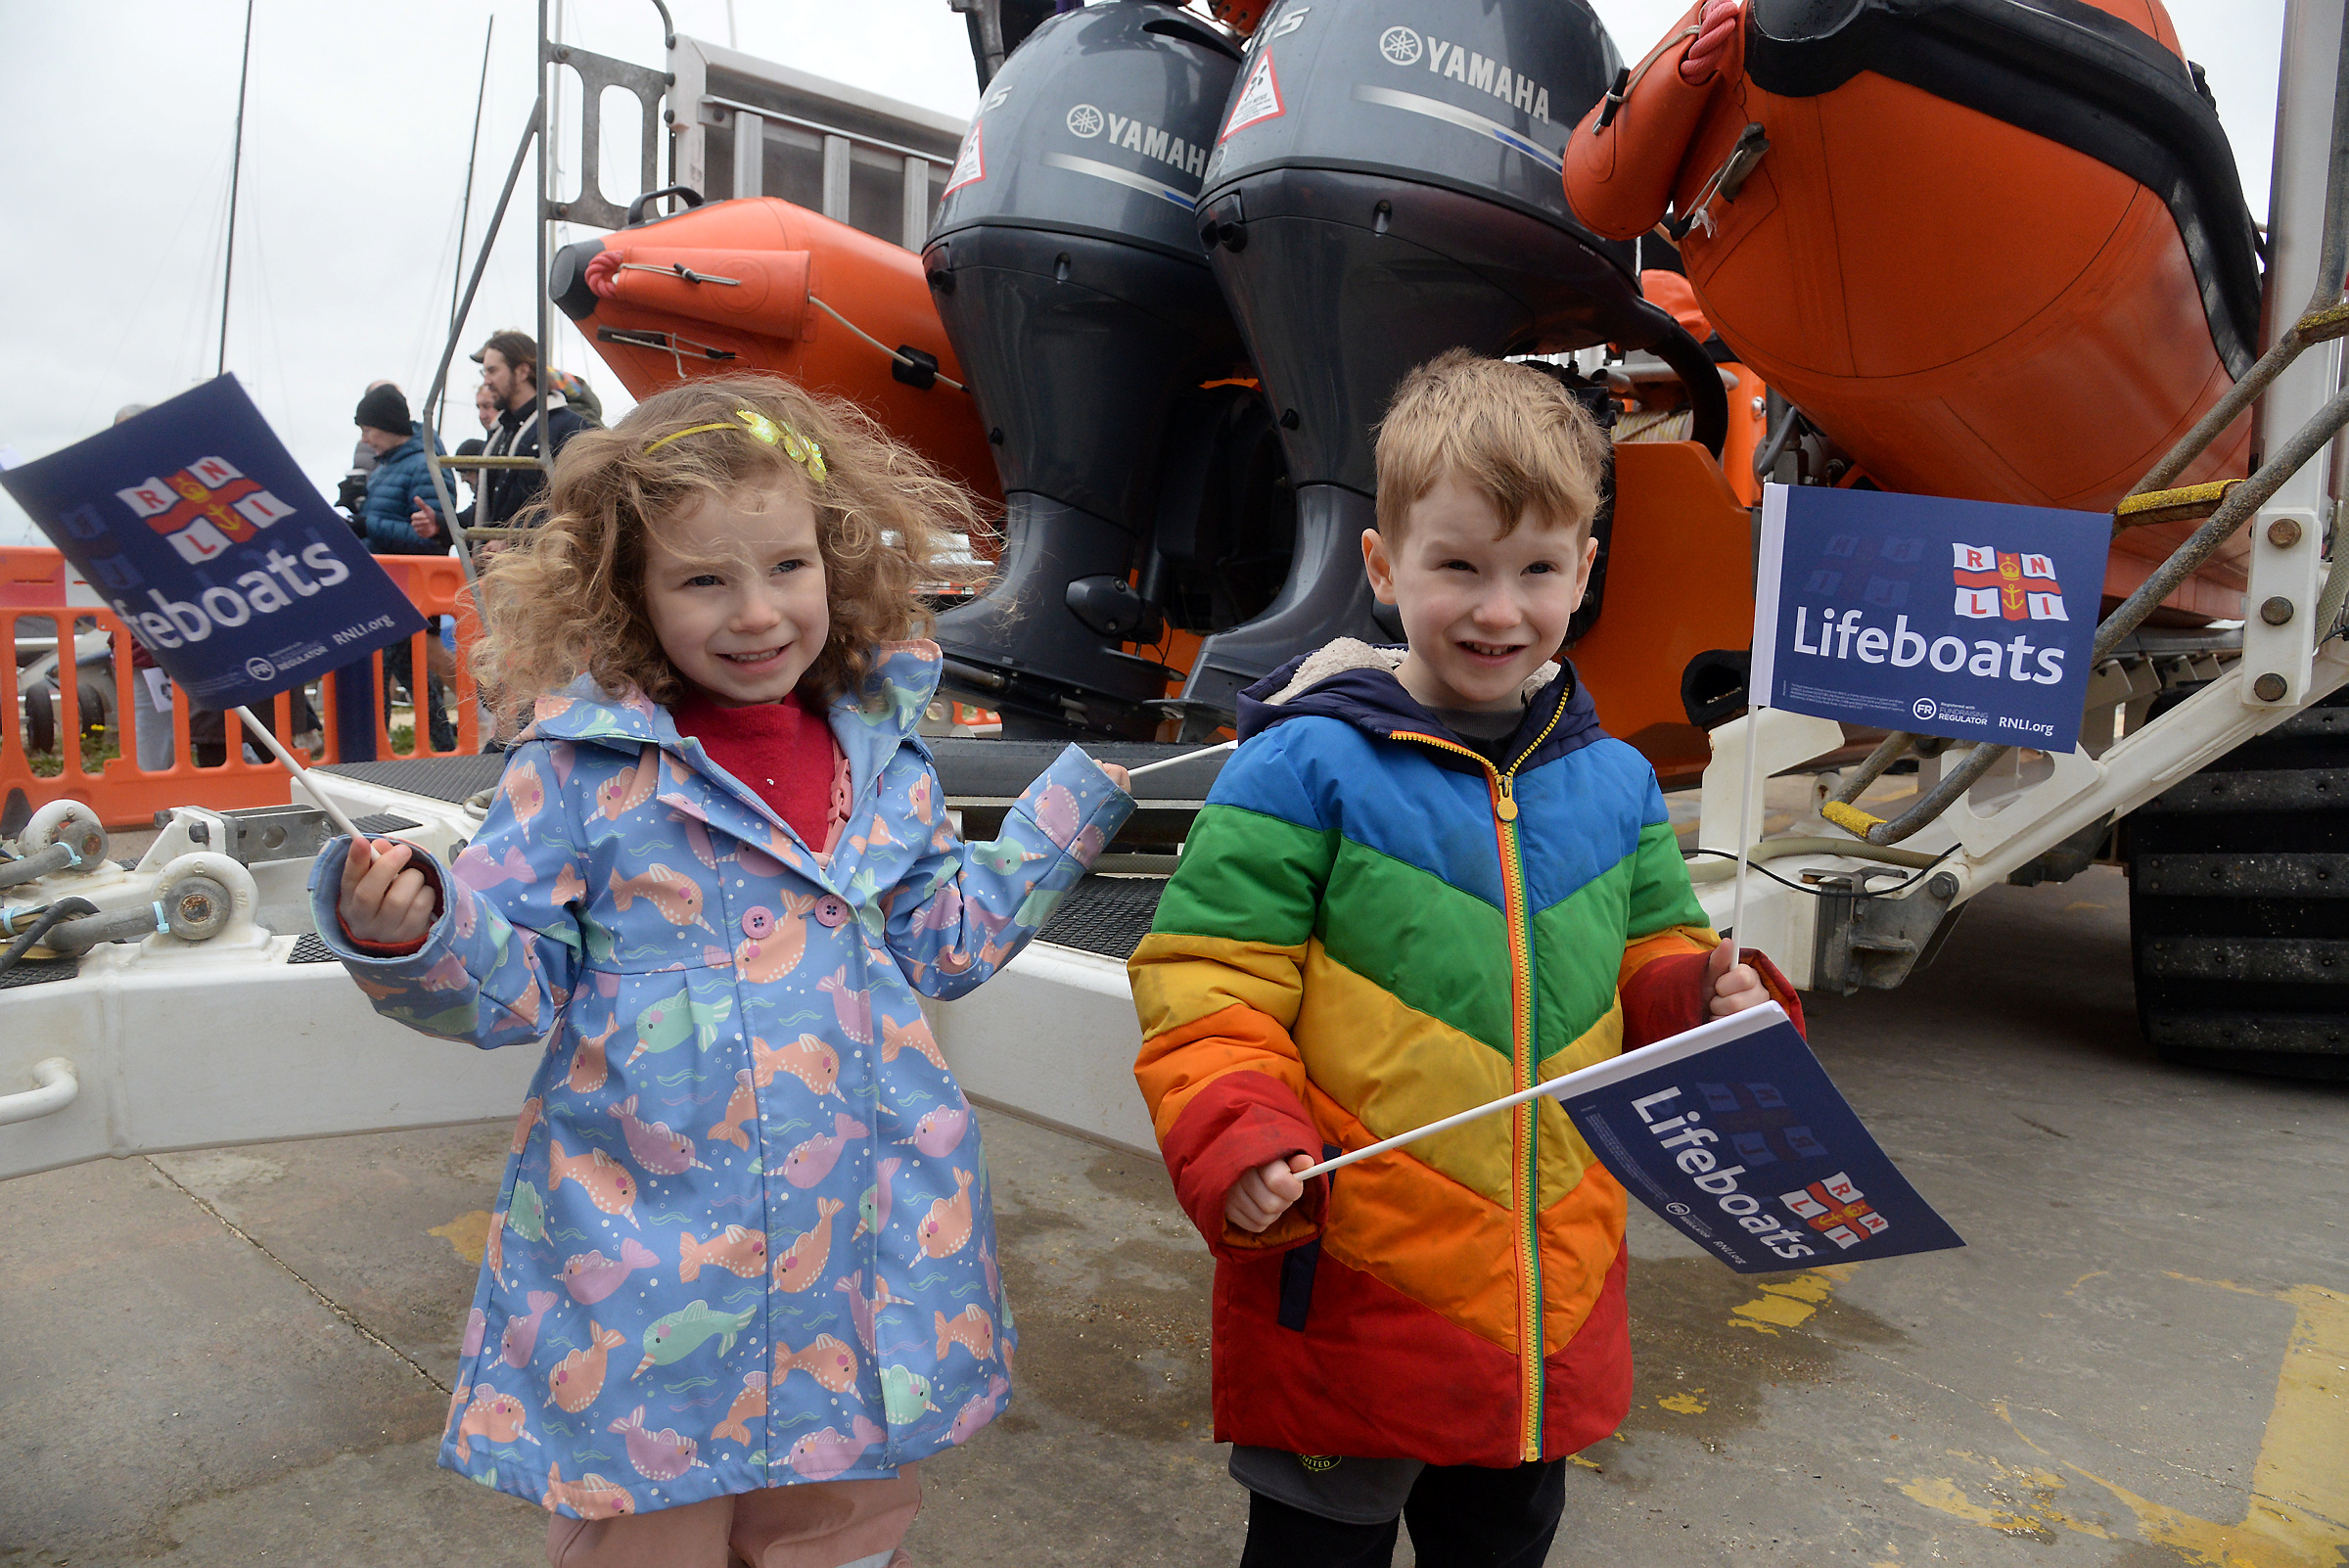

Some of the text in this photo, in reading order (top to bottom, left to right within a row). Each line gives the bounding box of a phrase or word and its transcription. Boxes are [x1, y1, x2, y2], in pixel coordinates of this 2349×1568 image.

[1426, 35, 1549, 125] YAMAHA
[1107, 112, 1207, 178] YAMAH
[1966, 548, 2047, 574] R N
[1970, 593, 1987, 615] L
[332, 614, 395, 646] RNLI.org
[1793, 606, 2065, 685] Lifeboats
[252, 663, 271, 675] FR
[277, 646, 329, 671] REGULATOR
[1916, 704, 1933, 715] FR
[1938, 713, 1988, 726] REGULATOR
[1939, 707, 1989, 719] FUNDRAISING
[1999, 716, 2054, 737] RNLI.org
[1631, 1085, 1816, 1259] Lifeboats
[1712, 1240, 1747, 1265] RNLI.org
[1301, 1453, 1331, 1468] NITED
